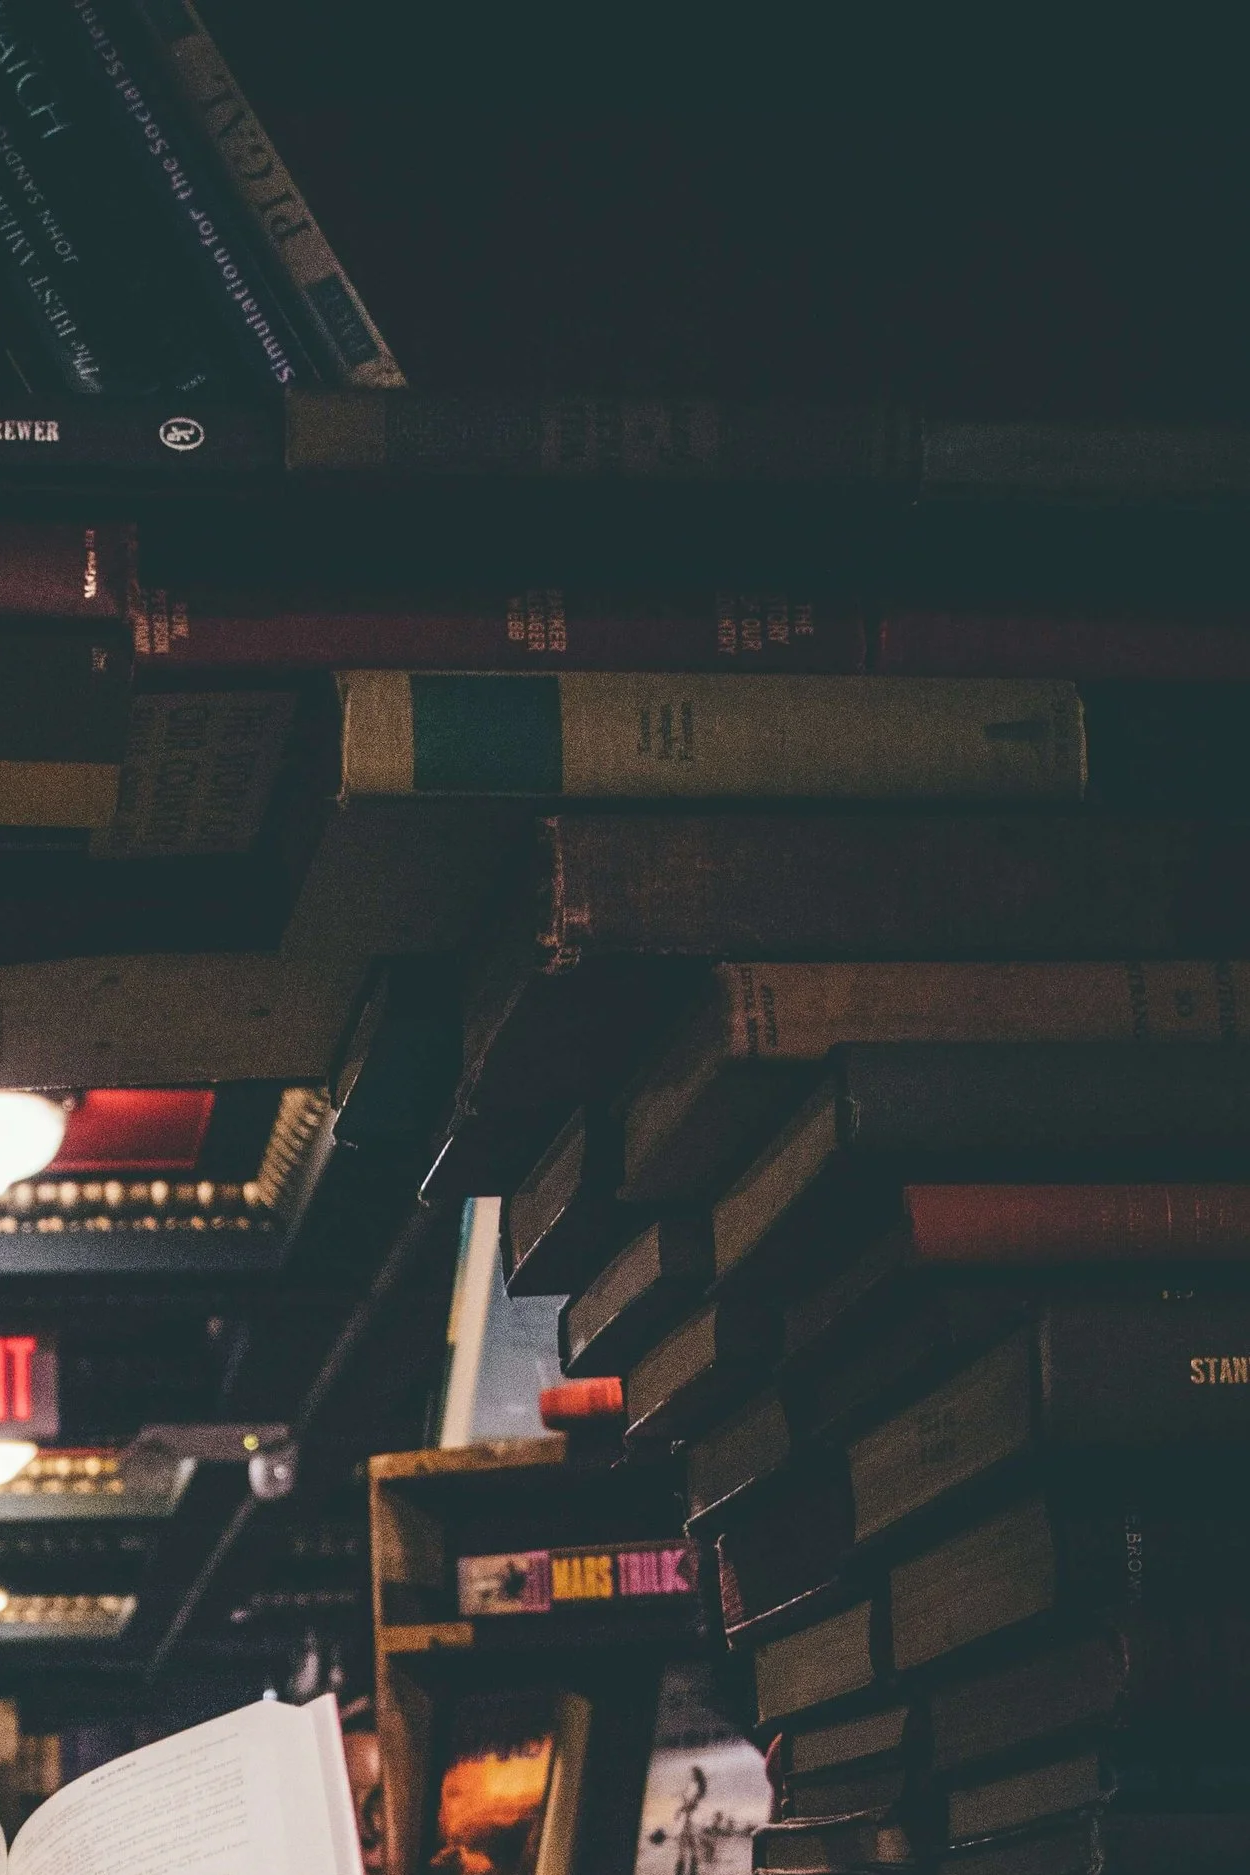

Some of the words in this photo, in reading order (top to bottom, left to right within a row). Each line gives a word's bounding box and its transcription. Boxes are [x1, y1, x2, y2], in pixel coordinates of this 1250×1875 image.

[113, 77, 170, 156] Social
[156, 154, 195, 202] the
[36, 207, 80, 266] JOHN
[187, 204, 220, 246] for
[26, 271, 77, 338] BEST
[208, 246, 296, 384] Simulation
